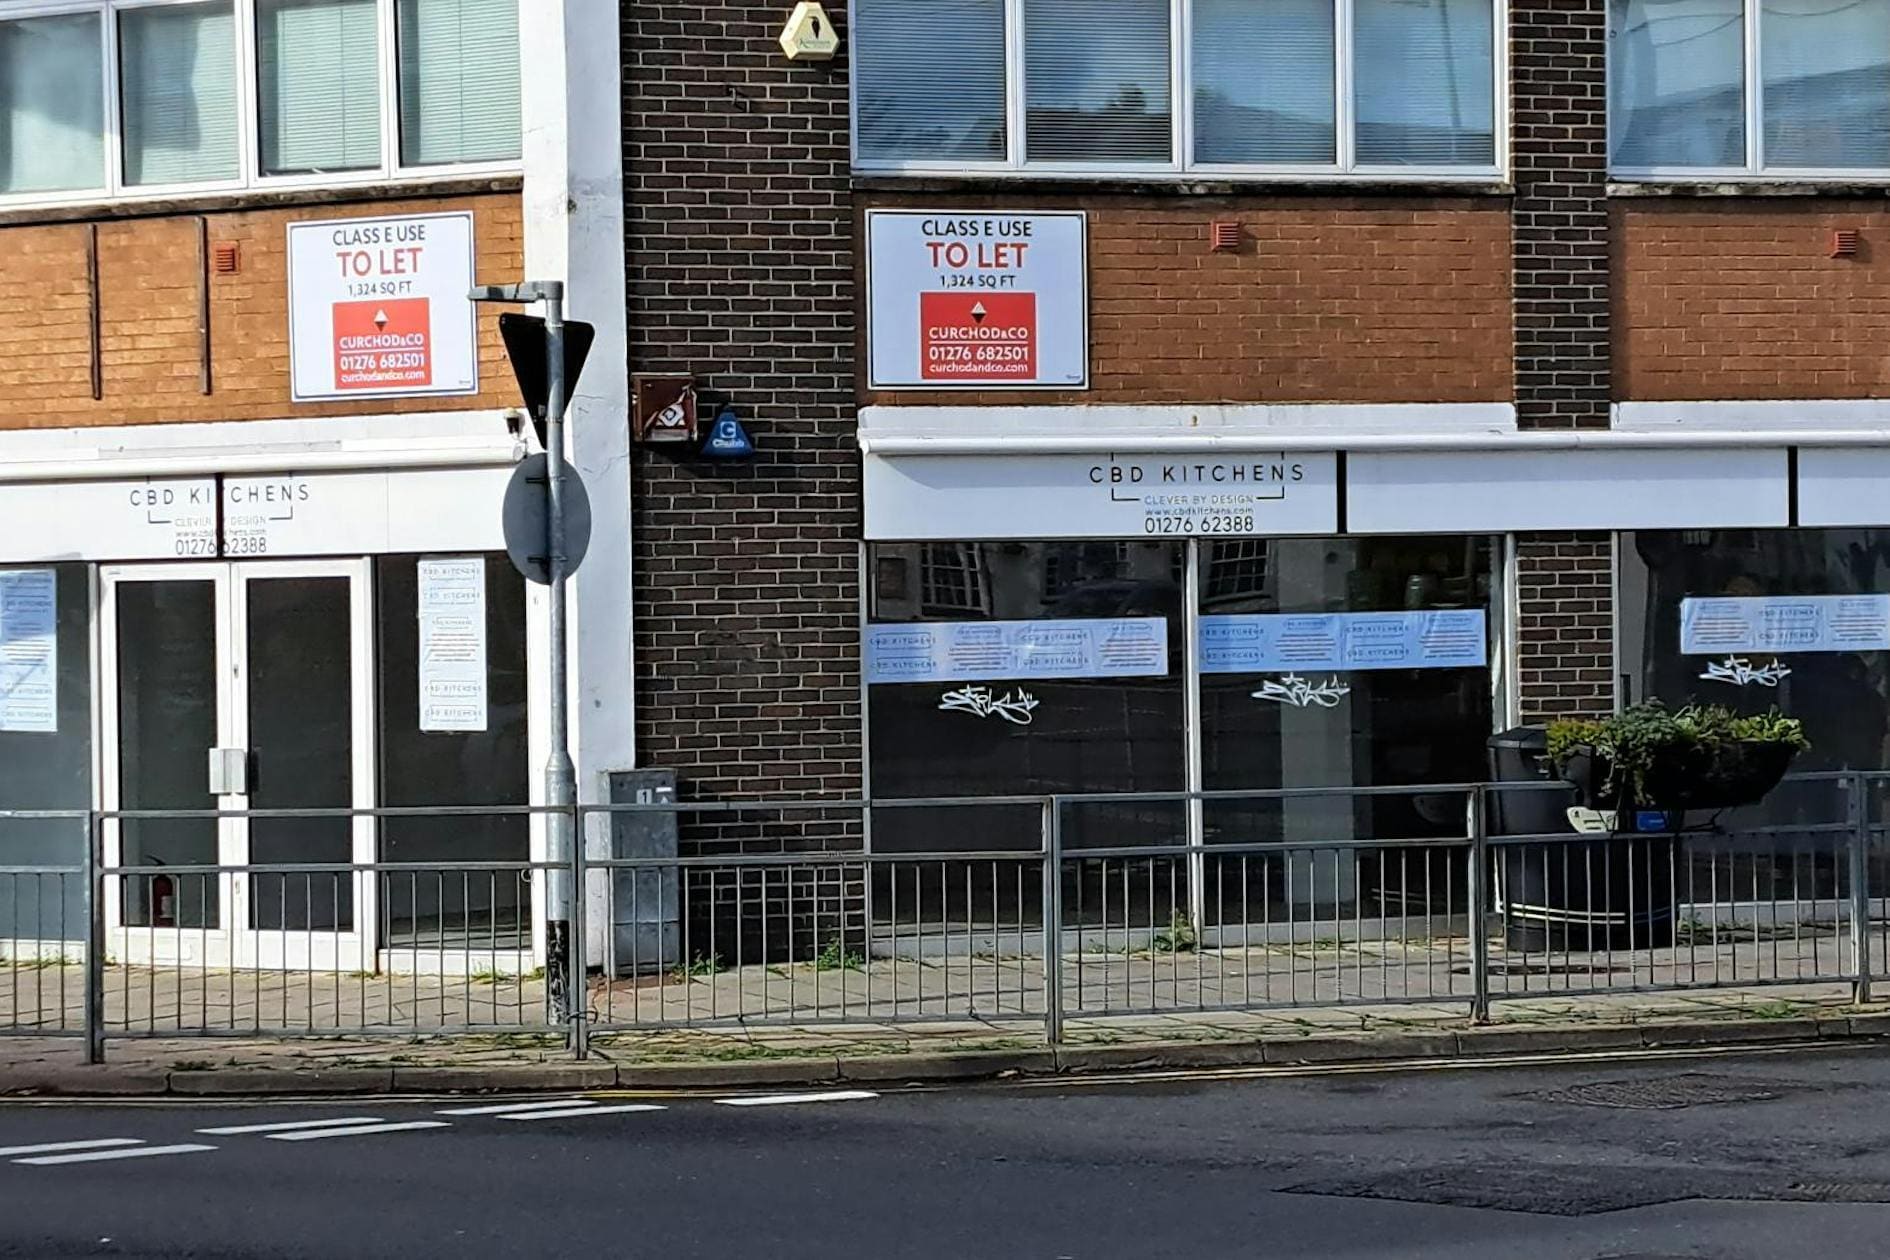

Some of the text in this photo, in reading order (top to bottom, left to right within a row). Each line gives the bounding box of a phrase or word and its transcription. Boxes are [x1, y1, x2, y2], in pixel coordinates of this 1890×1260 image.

[333, 225, 426, 246] CLASS E USE
[922, 220, 1032, 237] CLASS E USE
[336, 247, 423, 277] TO LET
[926, 241, 1028, 268] TO LET
[349, 281, 412, 297] 1,324 SQ FT
[941, 275, 1016, 289] 1,324 SQ FT
[340, 353, 424, 371] 01276 682501
[929, 346, 1028, 361] 01276 682501
[929, 362, 1028, 373] curchodandco.com
[1089, 464, 1303, 483] CBD KITCHENS
[129, 484, 309, 506] CBD KICHENS
[1144, 495, 1254, 505] CLEVER BY DESIGN
[1145, 516, 1253, 533] 01276 62388
[176, 539, 216, 555] 01276
